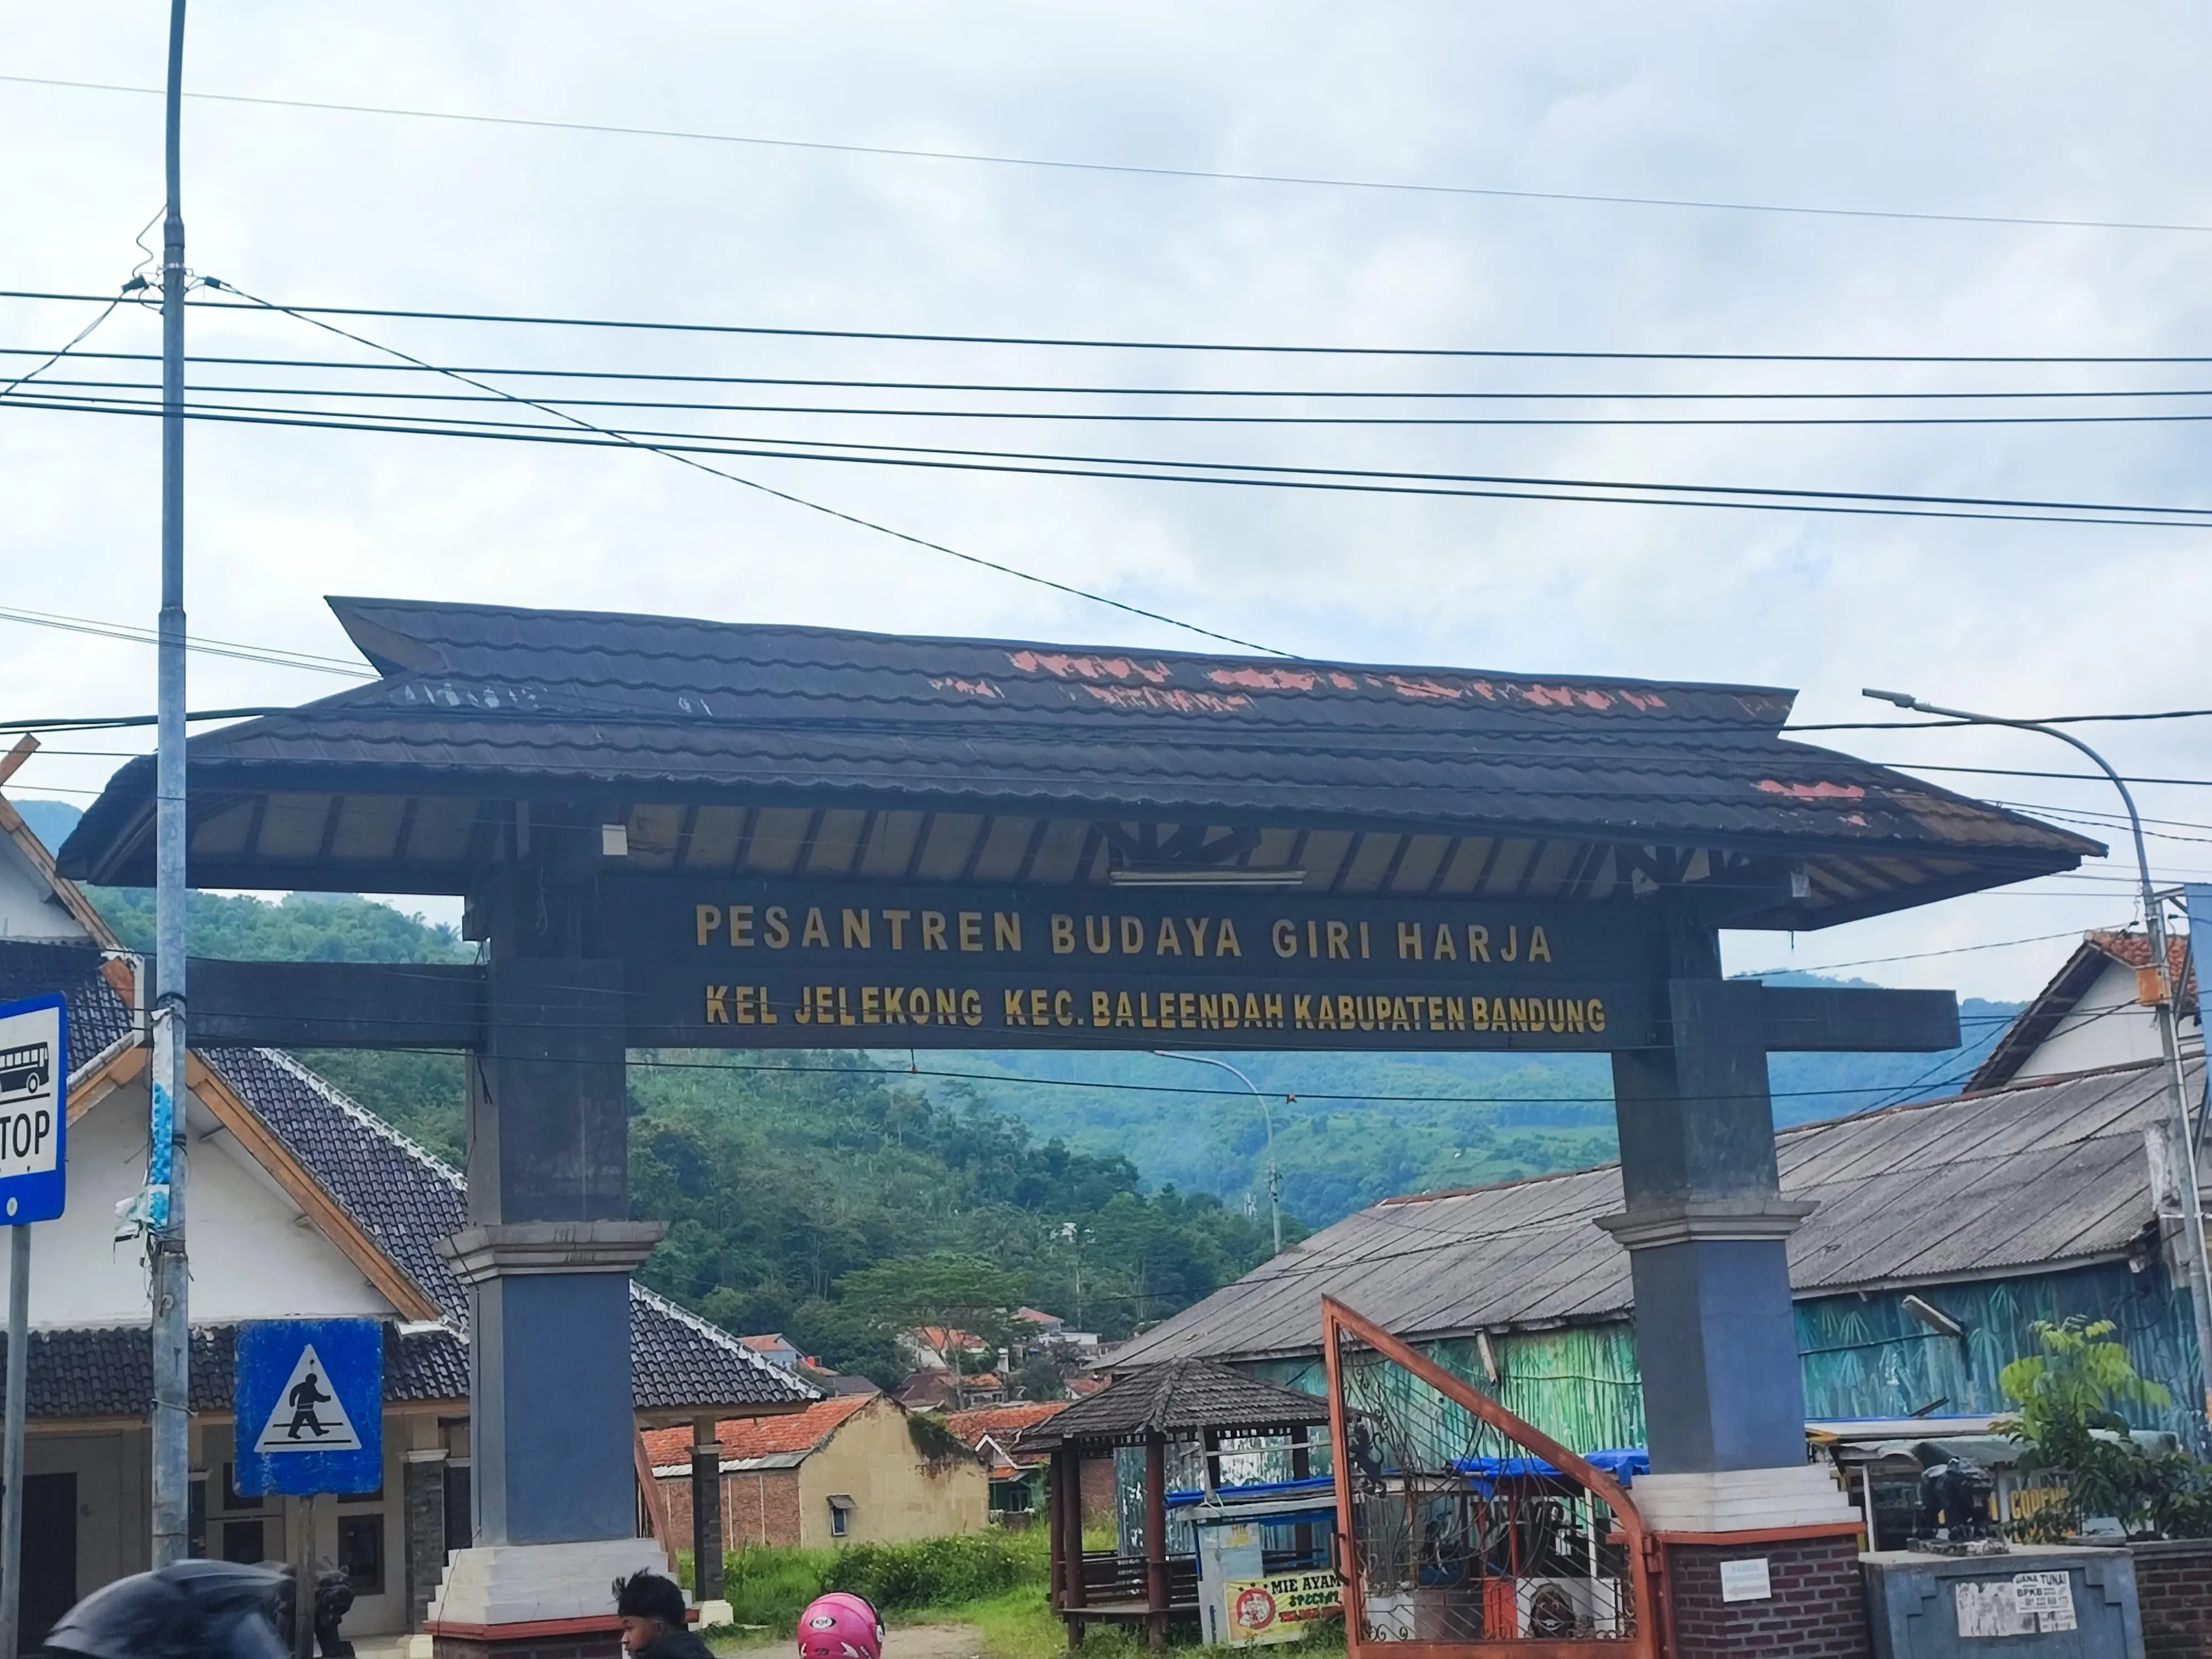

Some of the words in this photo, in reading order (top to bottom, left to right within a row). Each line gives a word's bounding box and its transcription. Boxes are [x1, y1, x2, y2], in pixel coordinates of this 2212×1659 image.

[696, 905, 1021, 952] PESANTREN
[1051, 914, 1241, 957] BUDAYA
[1272, 919, 1370, 959] GIRI
[1397, 922, 1552, 963] HARJA
[706, 985, 777, 1024] KEL
[795, 986, 983, 1026] JELEKONG
[1004, 989, 1084, 1026] KEC.
[1092, 990, 1284, 1029] BALEENDAH
[1293, 994, 1465, 1031] KABUPATEN
[1471, 997, 1606, 1034] BANDUNG
[0, 1110, 50, 1160] TOP
[1271, 1579, 1298, 1594] MIE
[1302, 1574, 1342, 1590] AYAM
